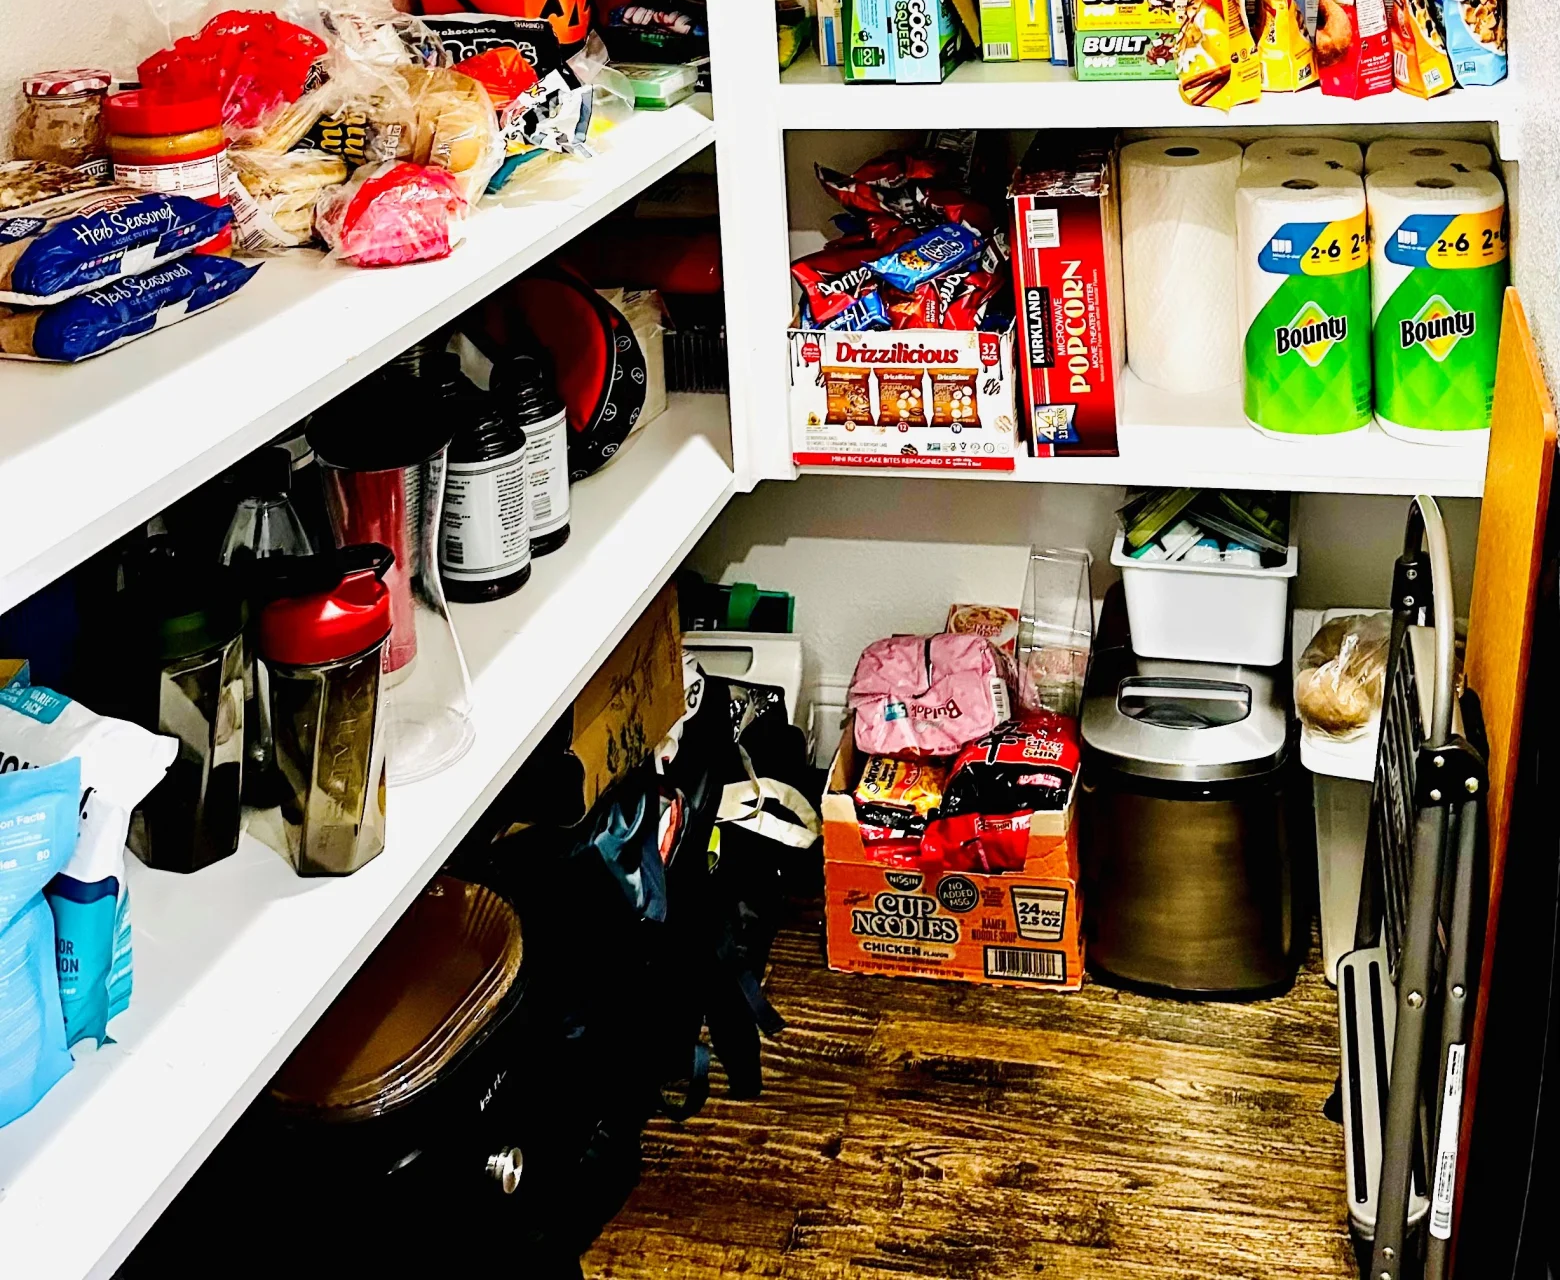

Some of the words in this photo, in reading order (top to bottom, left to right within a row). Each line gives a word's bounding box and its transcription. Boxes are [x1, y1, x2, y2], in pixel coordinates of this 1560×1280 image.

[441, 27, 497, 35] chocolate
[895, 0, 911, 59] SQUEEZ
[1082, 36, 1149, 54] BUILT
[72, 223, 113, 247] Herb
[114, 201, 176, 233] Seasoned
[86, 287, 130, 307] Herb
[123, 262, 193, 295] Seasoned
[817, 266, 874, 296] Dorito
[1085, 283, 1096, 311] BUTTER
[1027, 289, 1045, 364] KIRKLAND
[1053, 298, 1067, 356] MICROWAVE
[1059, 259, 1092, 394] POPCORN
[1087, 312, 1098, 345] THEATER
[1275, 316, 1347, 355] Bounty
[1400, 311, 1475, 348] Bounty
[836, 342, 959, 364] Drizzilicious
[982, 342, 997, 354] 32
[1089, 345, 1100, 369] MOVIE
[898, 423, 908, 431] 12
[1037, 408, 1057, 440] 44
[901, 457, 942, 465] REIMAGINED
[21, 699, 43, 716] PACK
[29, 688, 60, 709] VARIETY
[910, 698, 963, 720] Buldak
[1022, 747, 1060, 760] SHIN
[16, 812, 46, 825] Facts
[36, 848, 50, 861] 80
[889, 873, 919, 885] NISSIN
[948, 882, 963, 891] NO
[943, 889, 973, 899] ADDED
[949, 898, 971, 907] MSG
[877, 895, 937, 916] CUP
[1018, 902, 1041, 915] 24
[1041, 909, 1060, 917] PACK
[853, 913, 958, 941] NOODLES
[981, 918, 1007, 930] RAMEN
[1019, 915, 1041, 926] 2.5
[1042, 917, 1061, 927] OZ
[971, 929, 999, 941] NOODLE
[998, 931, 1018, 943] SOUP
[863, 941, 921, 956] CHICKEN
